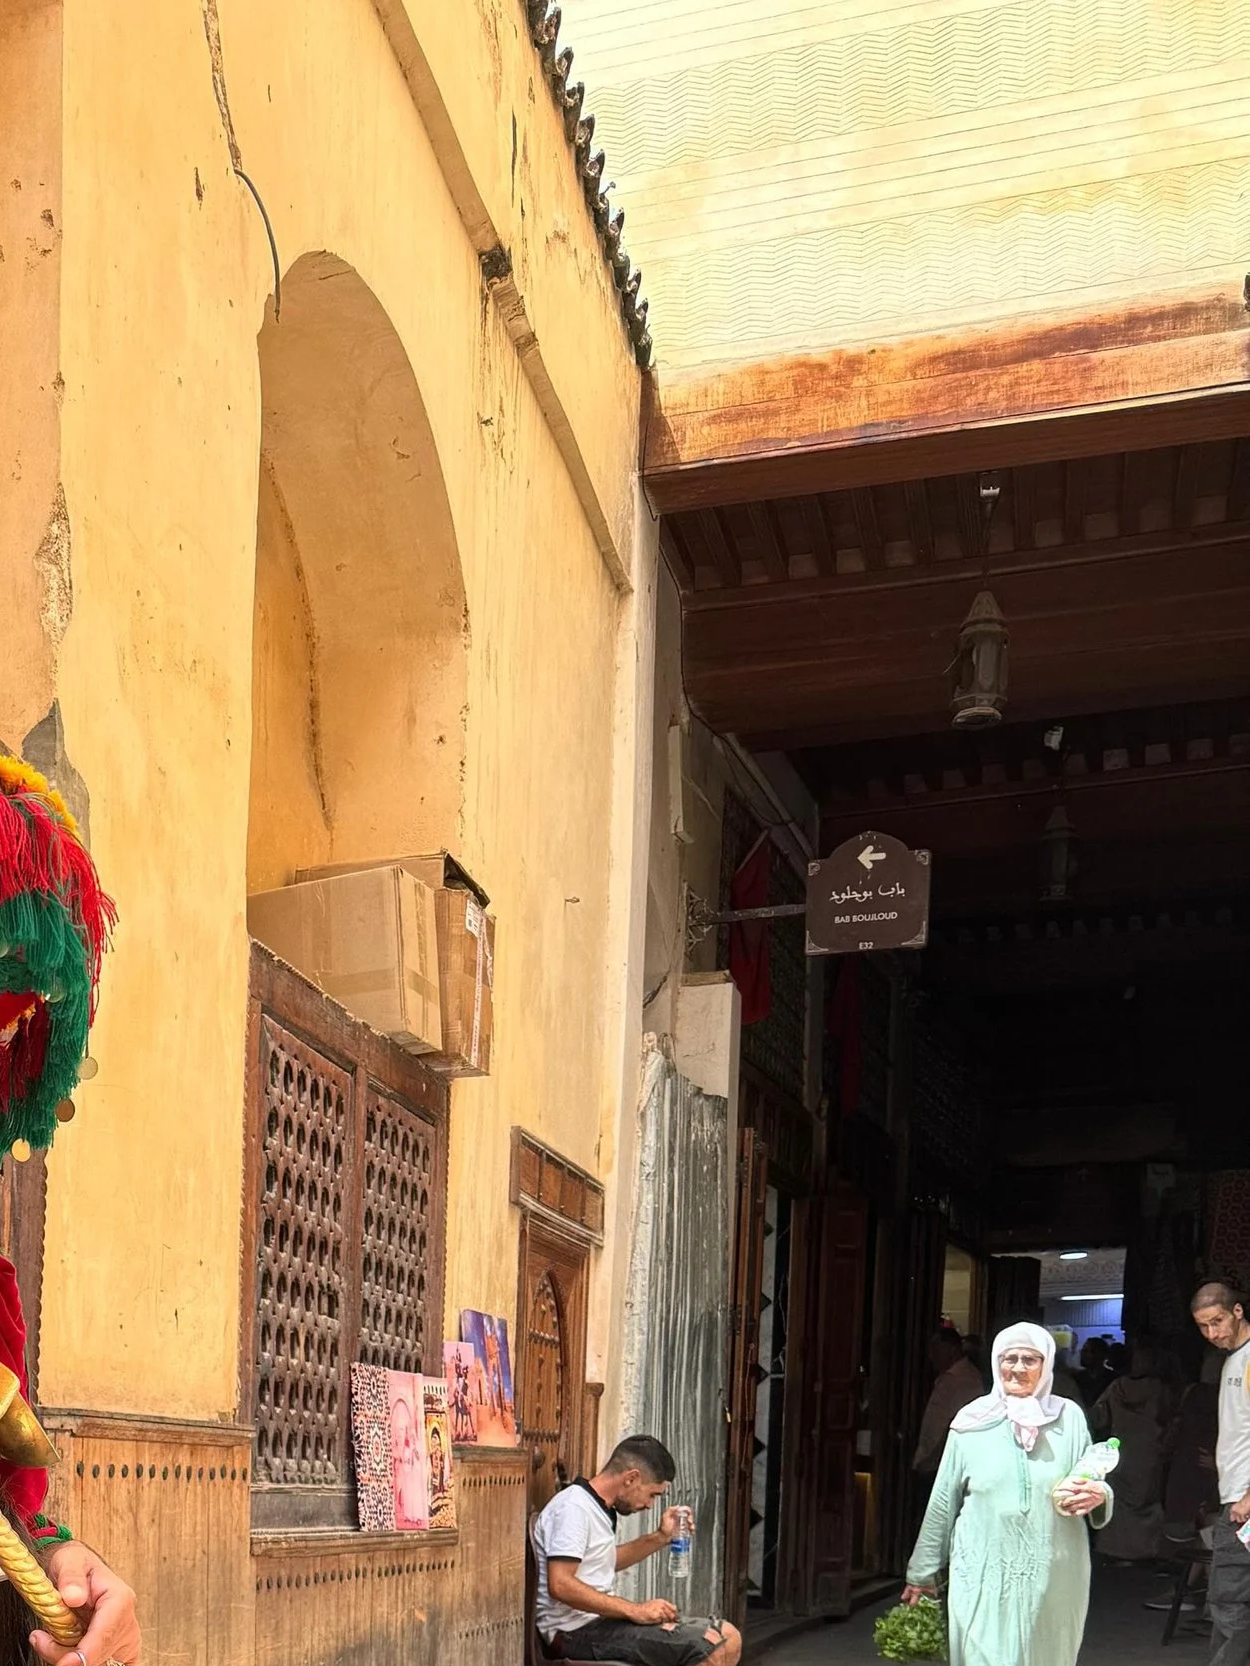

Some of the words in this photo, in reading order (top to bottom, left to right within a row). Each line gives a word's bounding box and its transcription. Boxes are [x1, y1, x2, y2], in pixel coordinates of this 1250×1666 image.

[829, 885, 873, 904] بوجلود
[878, 882, 905, 897] باب
[834, 914, 850, 924] BAB
[852, 911, 898, 923] BOUJLOUD
[858, 941, 874, 950] E32
